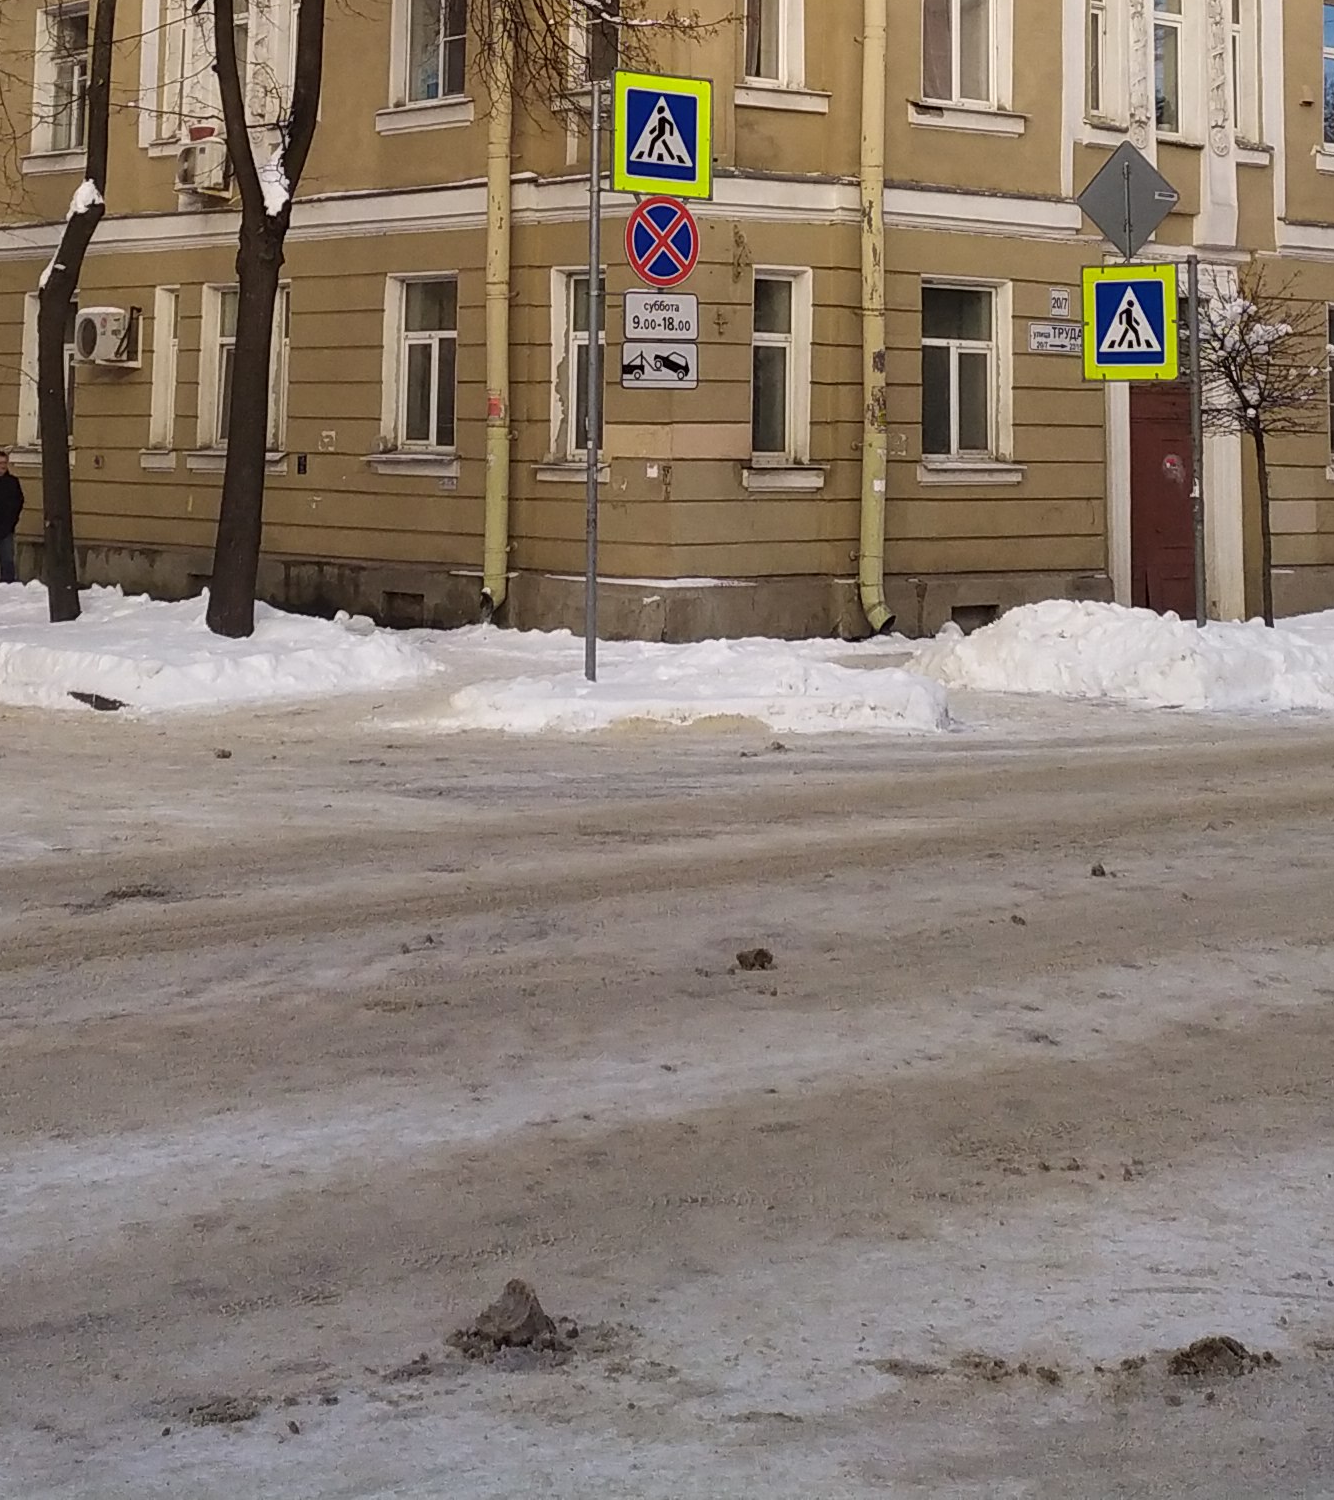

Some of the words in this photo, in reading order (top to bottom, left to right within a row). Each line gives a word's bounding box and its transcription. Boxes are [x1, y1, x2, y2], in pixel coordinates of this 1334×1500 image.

[643, 300, 680, 313] суббота
[1051, 297, 1068, 310] 20/7
[632, 315, 691, 331] 9.00-18.00
[1033, 331, 1051, 339] улица
